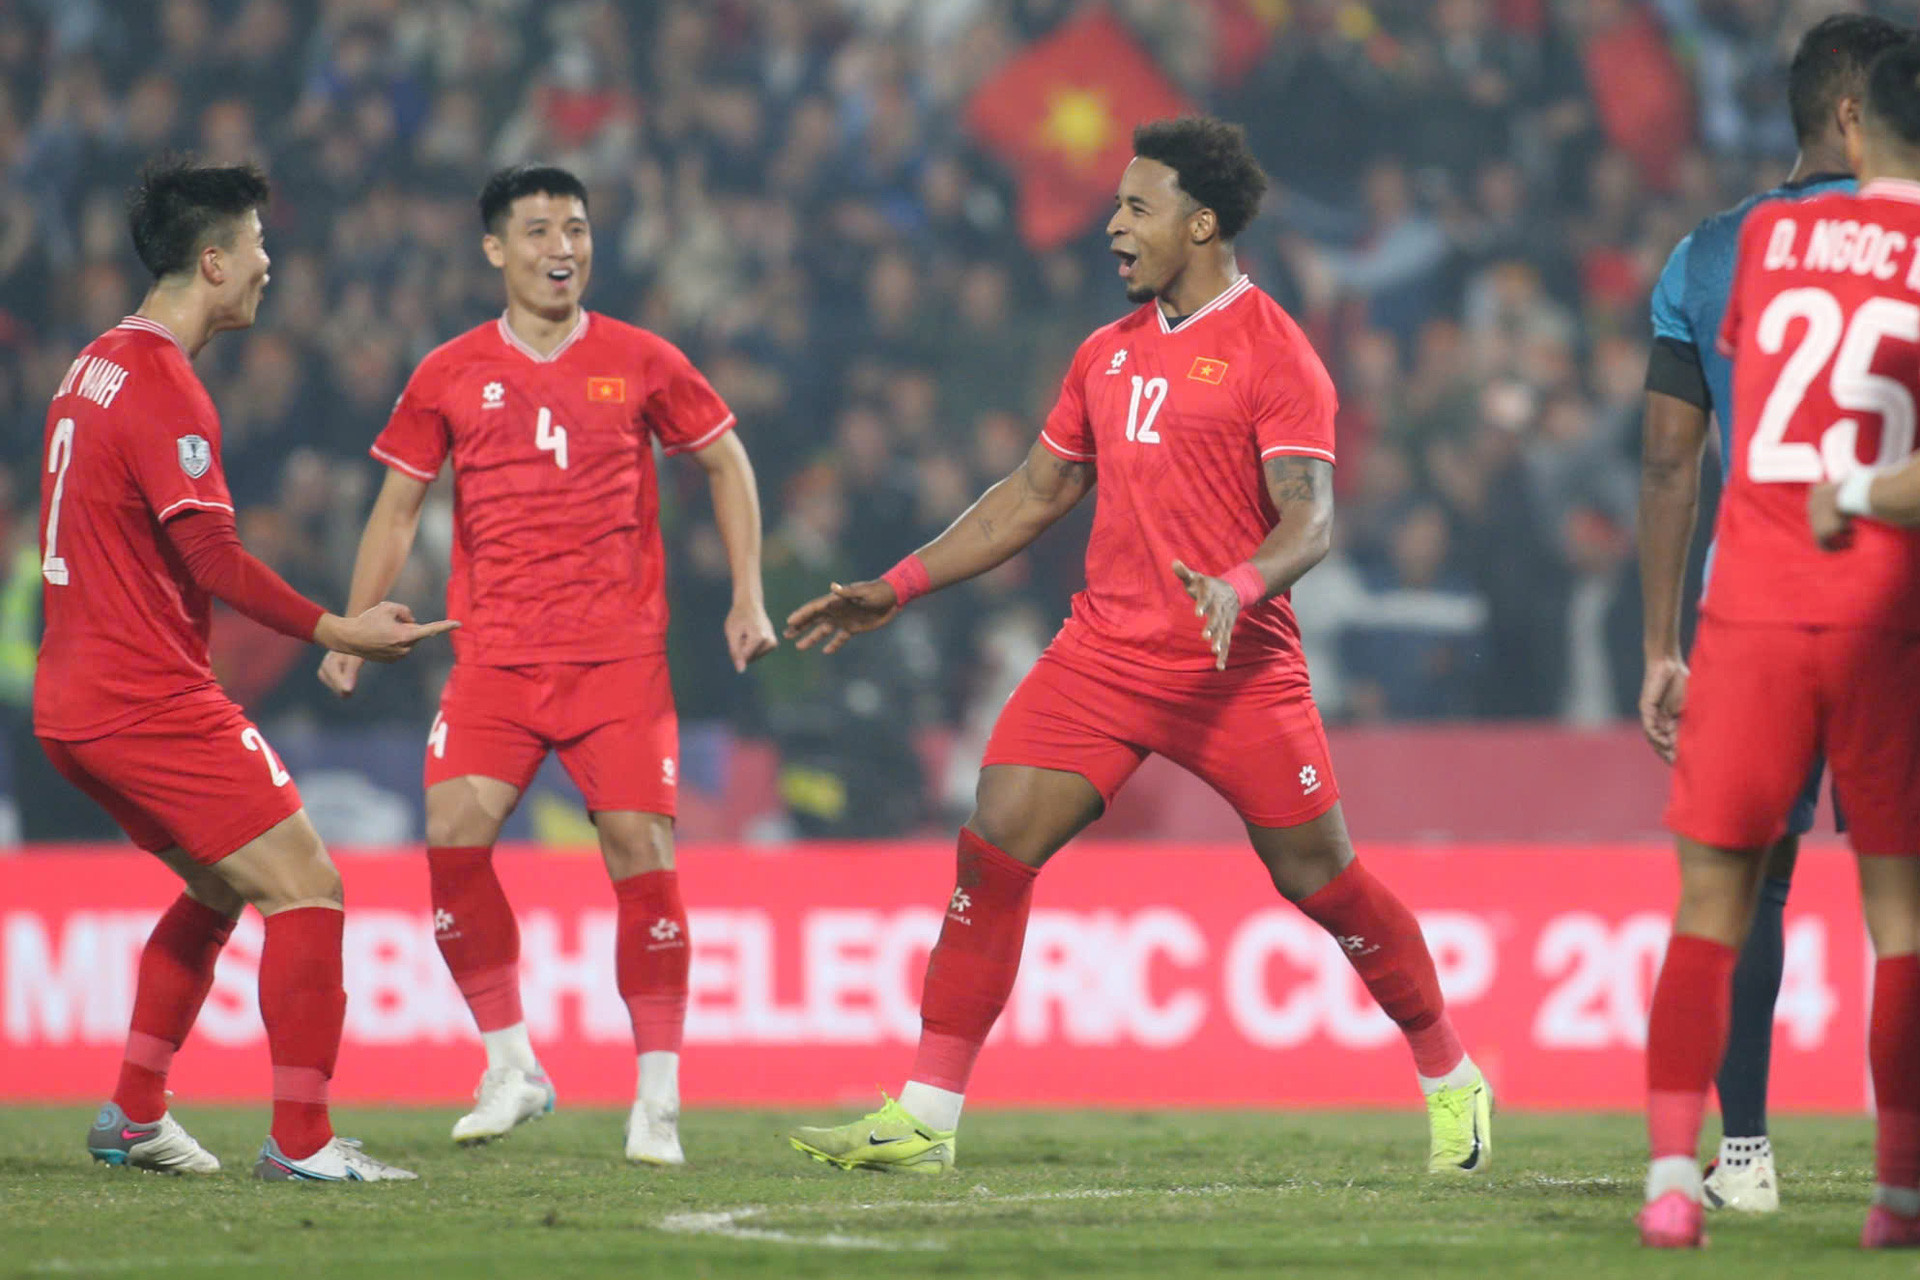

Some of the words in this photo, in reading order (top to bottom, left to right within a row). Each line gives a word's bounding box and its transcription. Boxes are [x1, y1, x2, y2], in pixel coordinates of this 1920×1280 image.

[1764, 218, 1797, 270] D.
[1803, 218, 1907, 281] NGOC
[1126, 375, 1168, 443] 12
[1748, 287, 1920, 484] 25
[535, 407, 568, 470] 4
[43, 418, 75, 585] 2
[241, 727, 290, 787] 2
[428, 710, 448, 758] 4
[1534, 912, 1838, 1050] 204
